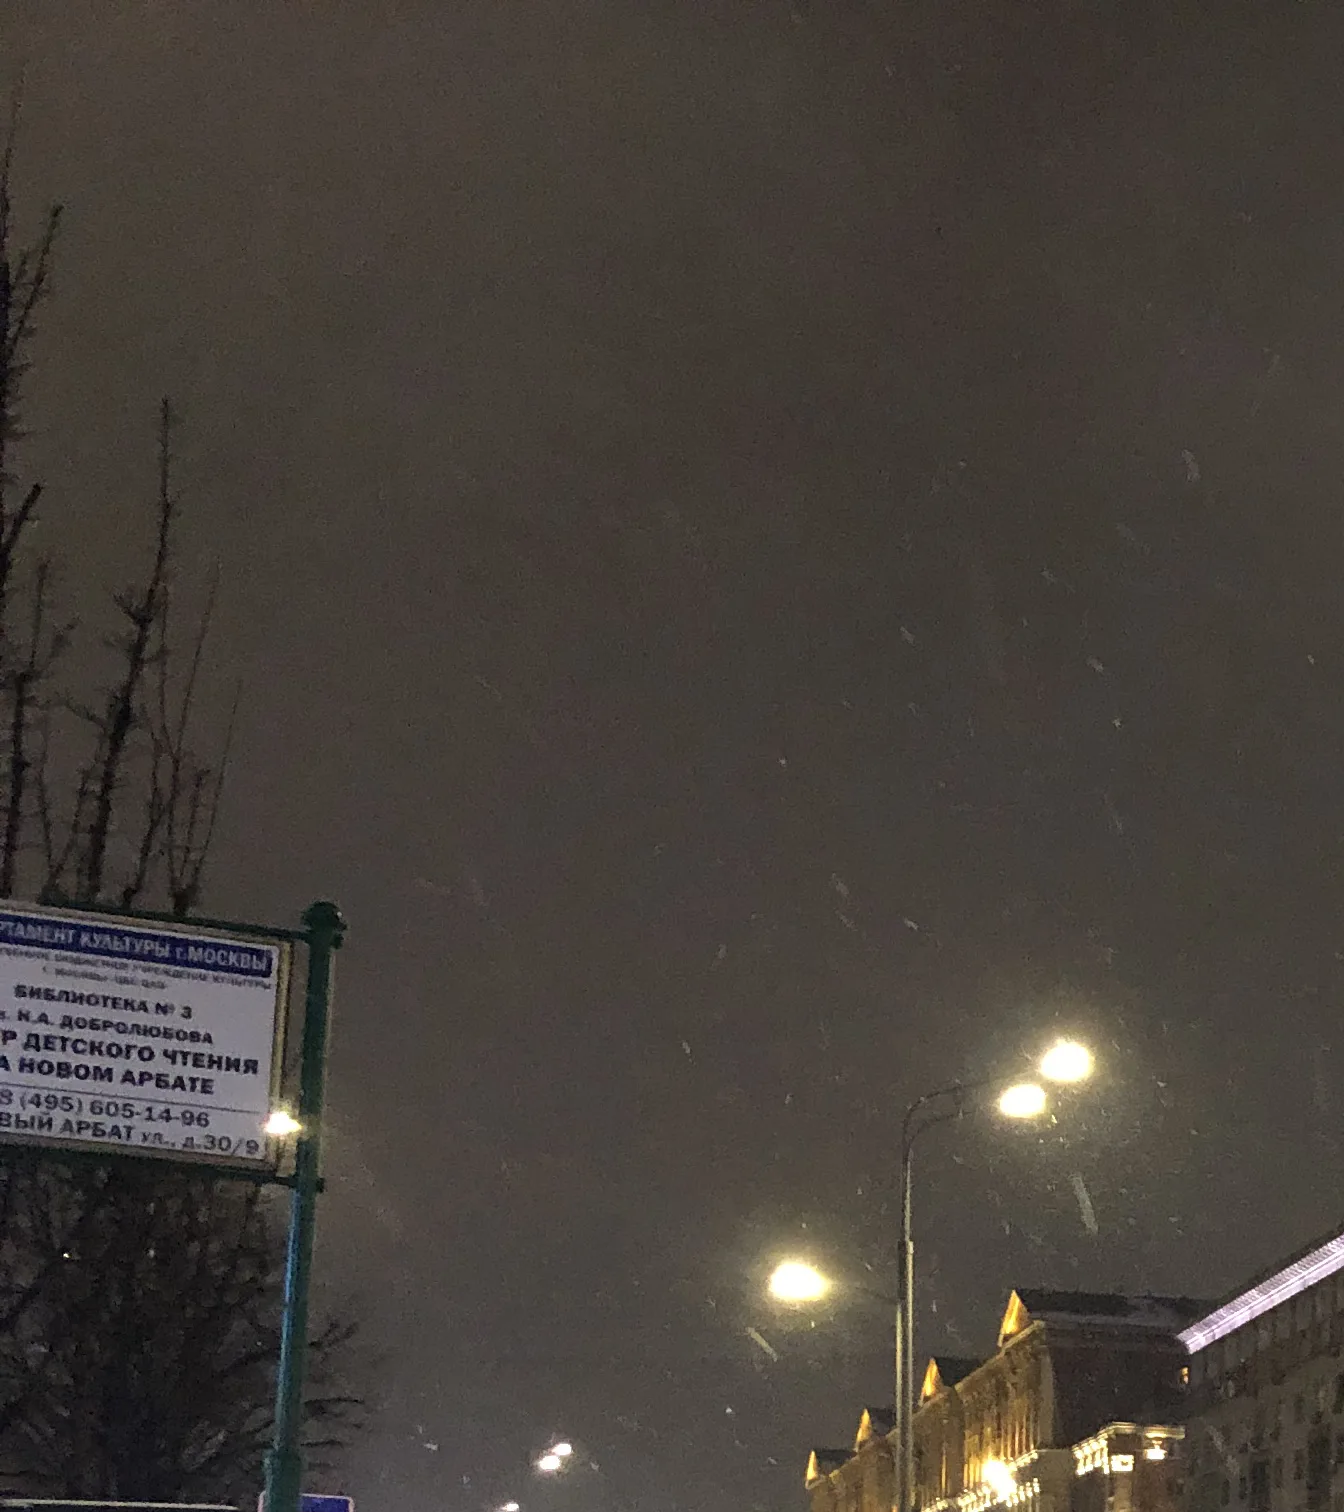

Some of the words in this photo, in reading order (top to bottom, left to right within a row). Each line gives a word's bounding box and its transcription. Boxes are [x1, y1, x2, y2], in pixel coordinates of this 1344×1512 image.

[0, 921, 75, 944] ТАМЕНТ
[80, 930, 170, 957] КУЛЬТУРЫ
[14, 985, 149, 1013] БИБЛИОТЕКА
[181, 1006, 193, 1020] 3
[59, 1014, 213, 1045] ДОБРОЛЮБОВА
[23, 1032, 155, 1062] ДЕТСКОГО
[162, 1050, 259, 1075] ЧТЕНИЯ
[19, 1056, 114, 1083] НОВОМ
[120, 1070, 215, 1095] АРБАТЕ
[20, 1091, 83, 1116] (495)
[89, 1100, 211, 1129] 605-14-96
[60, 1118, 135, 1142] АРБАТ
